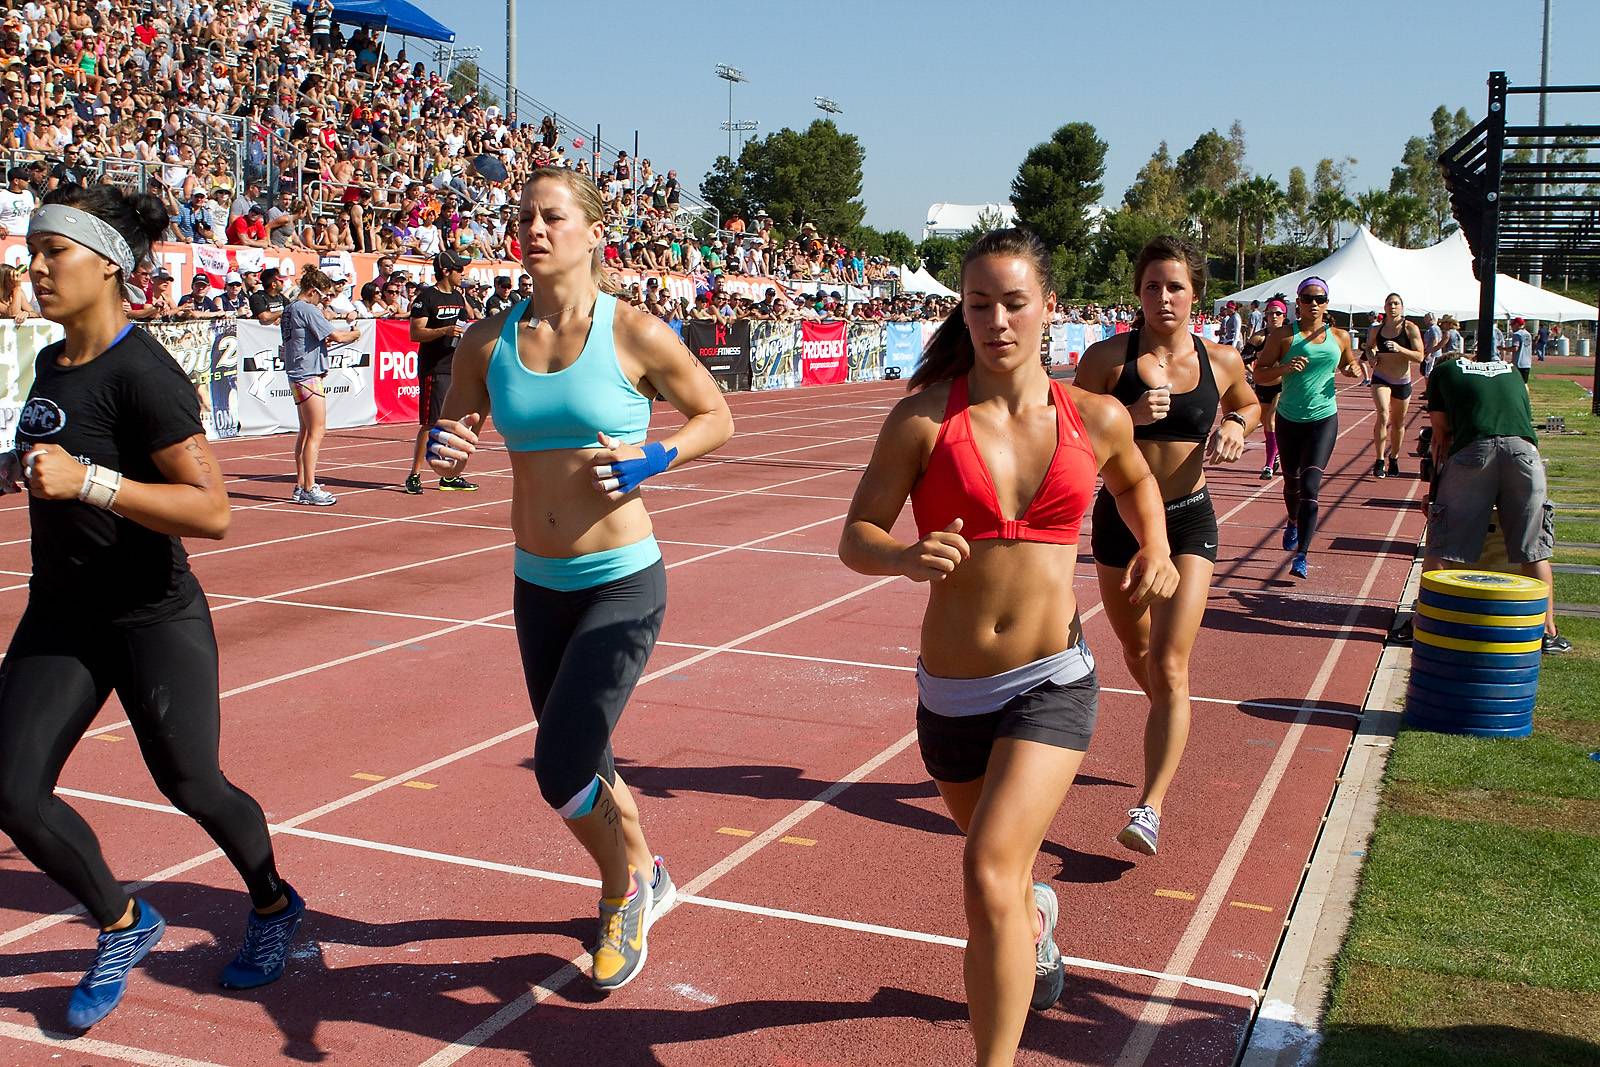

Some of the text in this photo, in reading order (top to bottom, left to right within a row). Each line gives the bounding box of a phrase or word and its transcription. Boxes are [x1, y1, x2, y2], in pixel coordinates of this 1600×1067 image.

[803, 340, 845, 359] PROGENEX
[379, 351, 419, 380] PRO
[397, 385, 420, 399] proge
[1187, 493, 1204, 505] PRO
